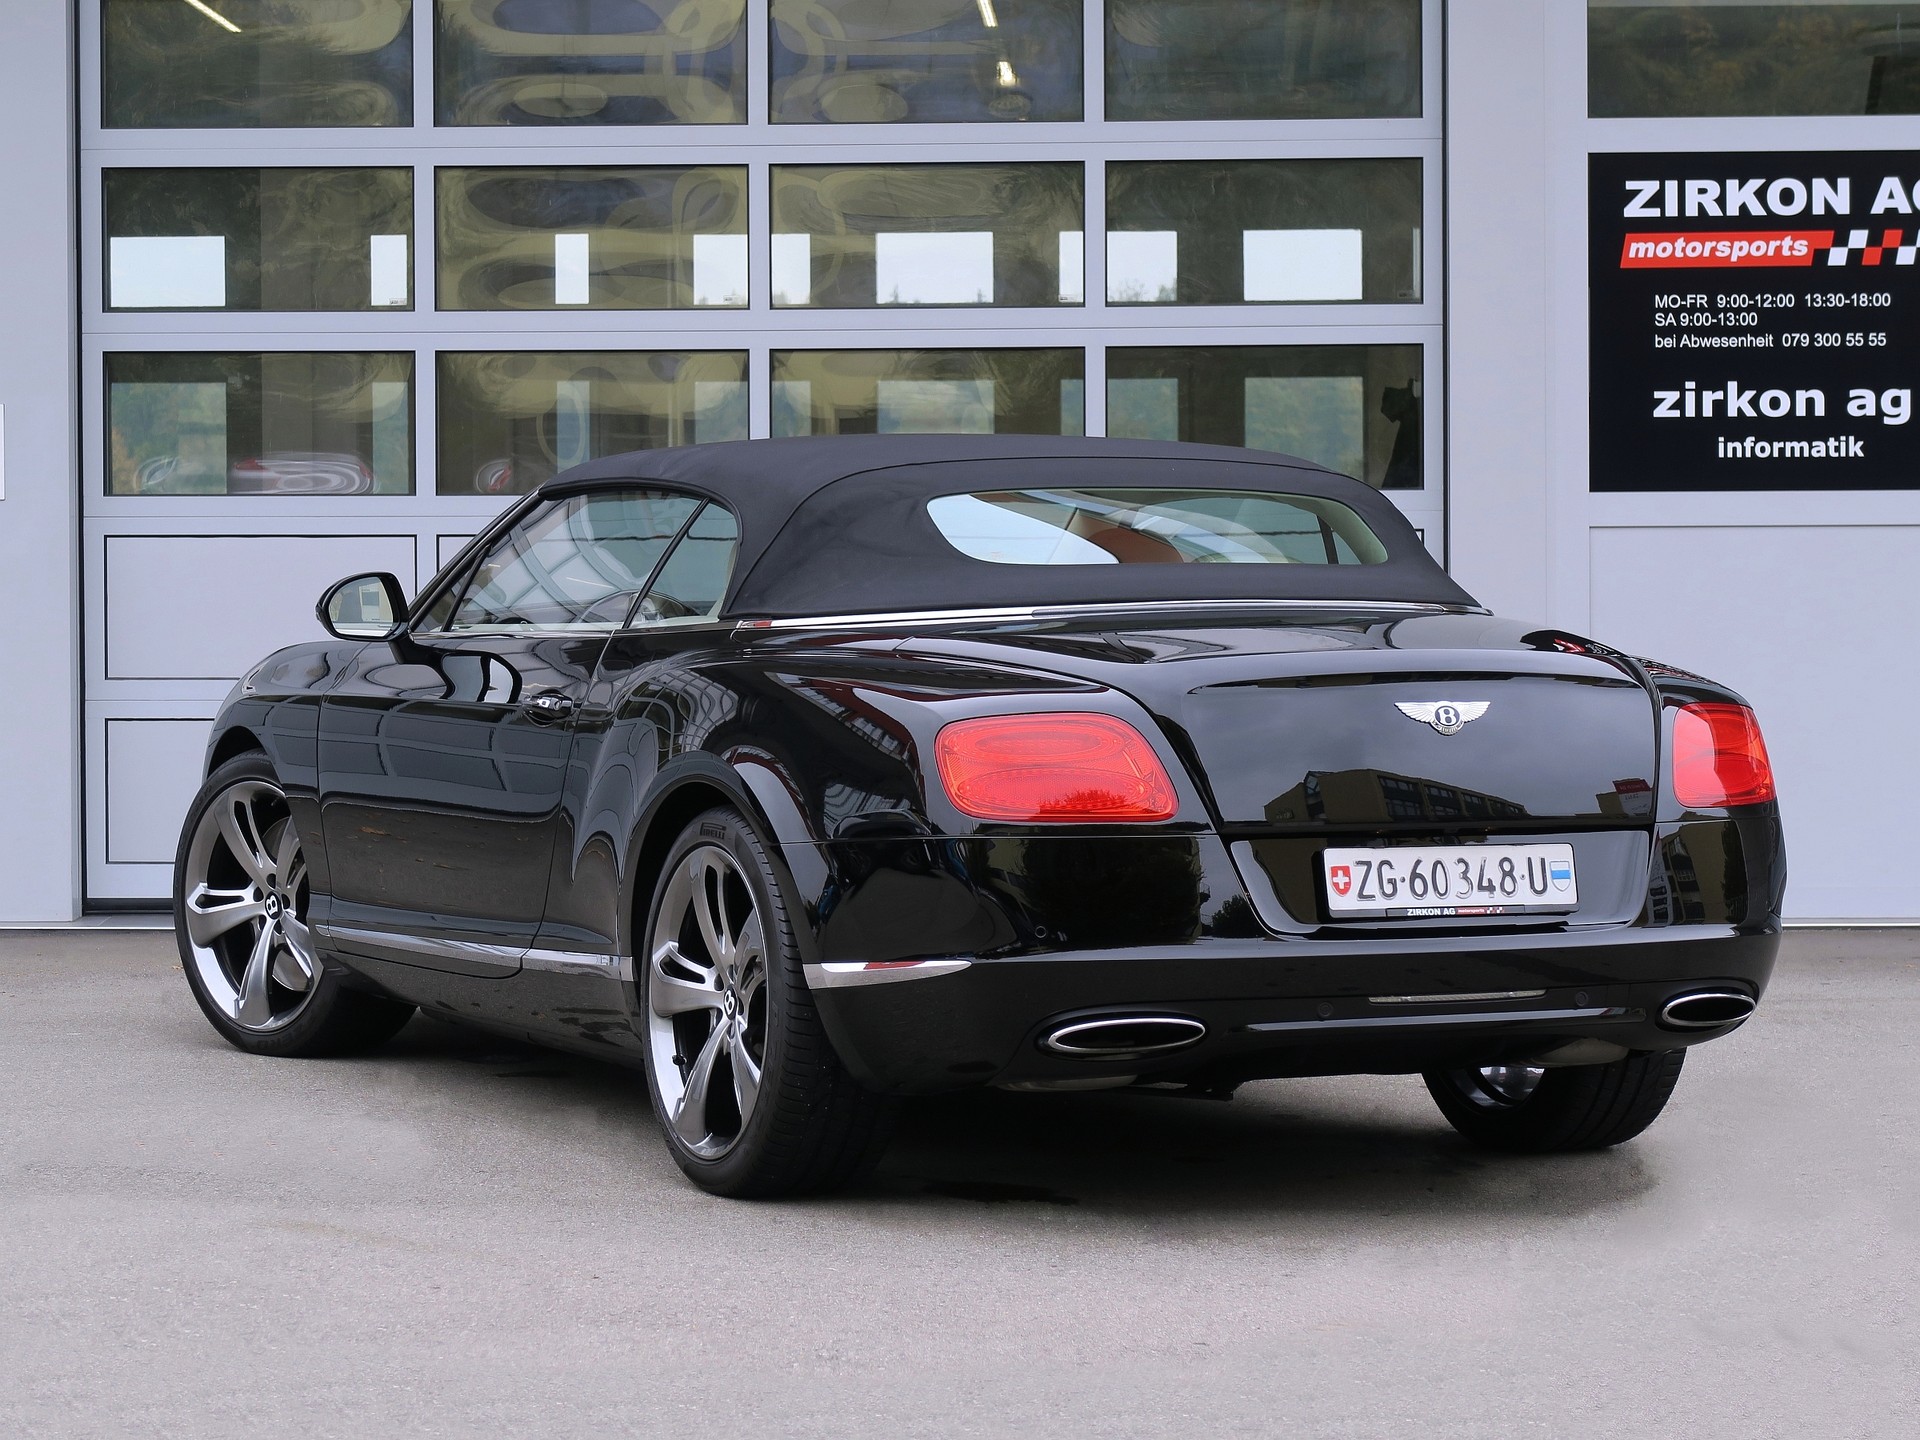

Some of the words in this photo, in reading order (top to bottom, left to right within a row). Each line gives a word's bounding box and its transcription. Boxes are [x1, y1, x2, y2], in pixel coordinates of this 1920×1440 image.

[1624, 178, 1850, 217] ZIRKON
[1871, 177, 1920, 214] A
[1629, 236, 1808, 261] motorsports
[1655, 295, 1708, 308] MO-FR
[1717, 294, 1794, 307] 9:00-12:00
[1805, 293, 1891, 307] 13:30-18:00
[1655, 313, 1676, 326] SA
[1680, 312, 1757, 326] 9:00-13:00
[1655, 334, 1676, 348] bei
[1680, 334, 1773, 347] Abwesenheit
[1783, 333, 1809, 347] 079
[1814, 333, 1841, 346] 300
[1846, 333, 1863, 346] 55
[1869, 333, 1886, 346] 55
[1653, 381, 1825, 417] zirkon
[1847, 389, 1911, 425] ag
[1719, 436, 1864, 458] informatik
[1406, 908, 1441, 916] ZIRKON
[1443, 907, 1456, 915] AG
